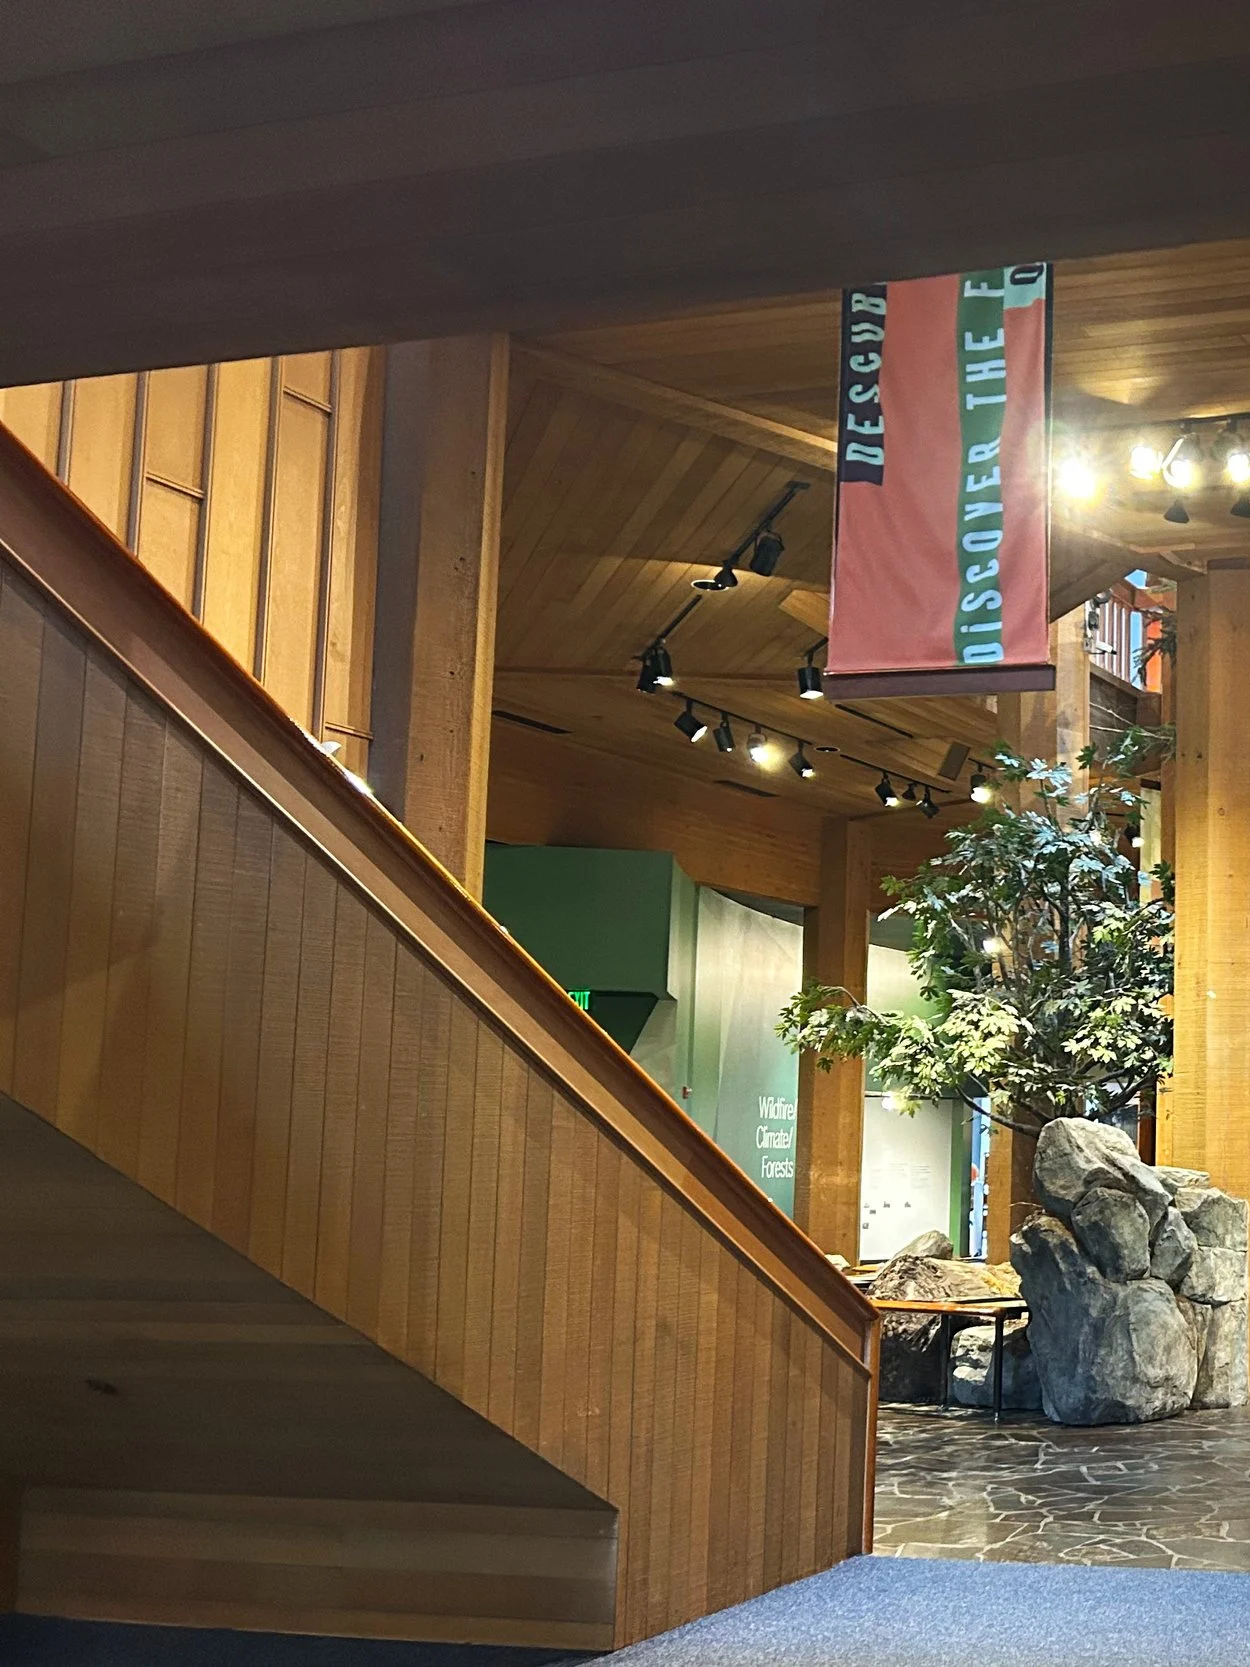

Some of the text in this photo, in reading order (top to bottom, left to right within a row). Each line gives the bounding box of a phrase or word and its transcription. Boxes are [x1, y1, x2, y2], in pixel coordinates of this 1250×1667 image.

[845, 292, 887, 466] DESCUB
[964, 327, 1007, 411] THE
[567, 991, 590, 1010] XIT
[756, 1125, 794, 1149] Climate/
[761, 1155, 794, 1179] Forests
